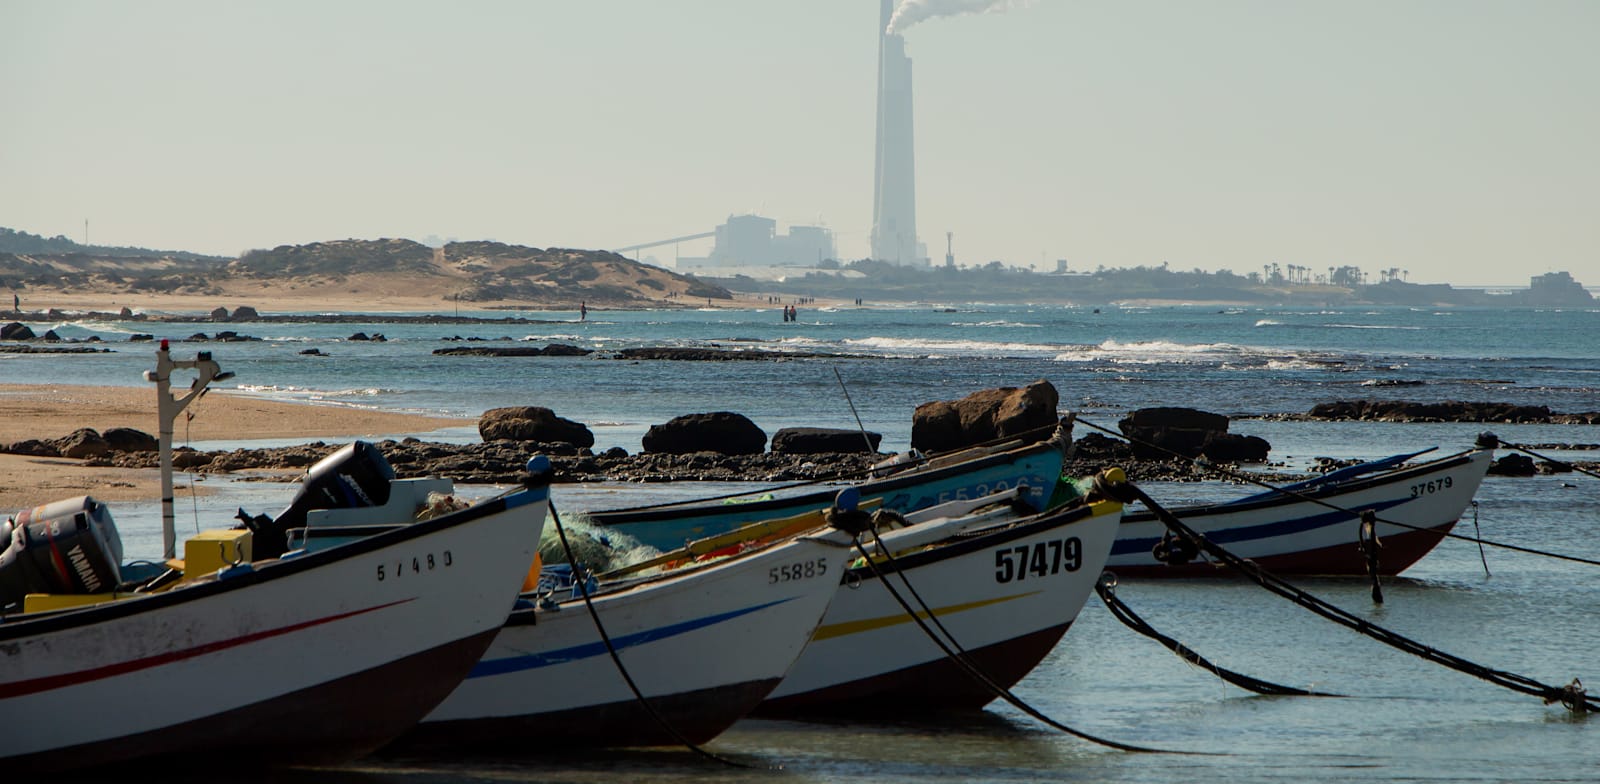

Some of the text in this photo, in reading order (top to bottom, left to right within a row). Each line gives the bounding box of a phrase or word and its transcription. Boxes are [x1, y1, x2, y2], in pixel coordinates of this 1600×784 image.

[1410, 476, 1453, 497] 37679
[67, 544, 102, 592] YAMAHA
[768, 557, 827, 584] 55885
[995, 536, 1083, 584] 57479
